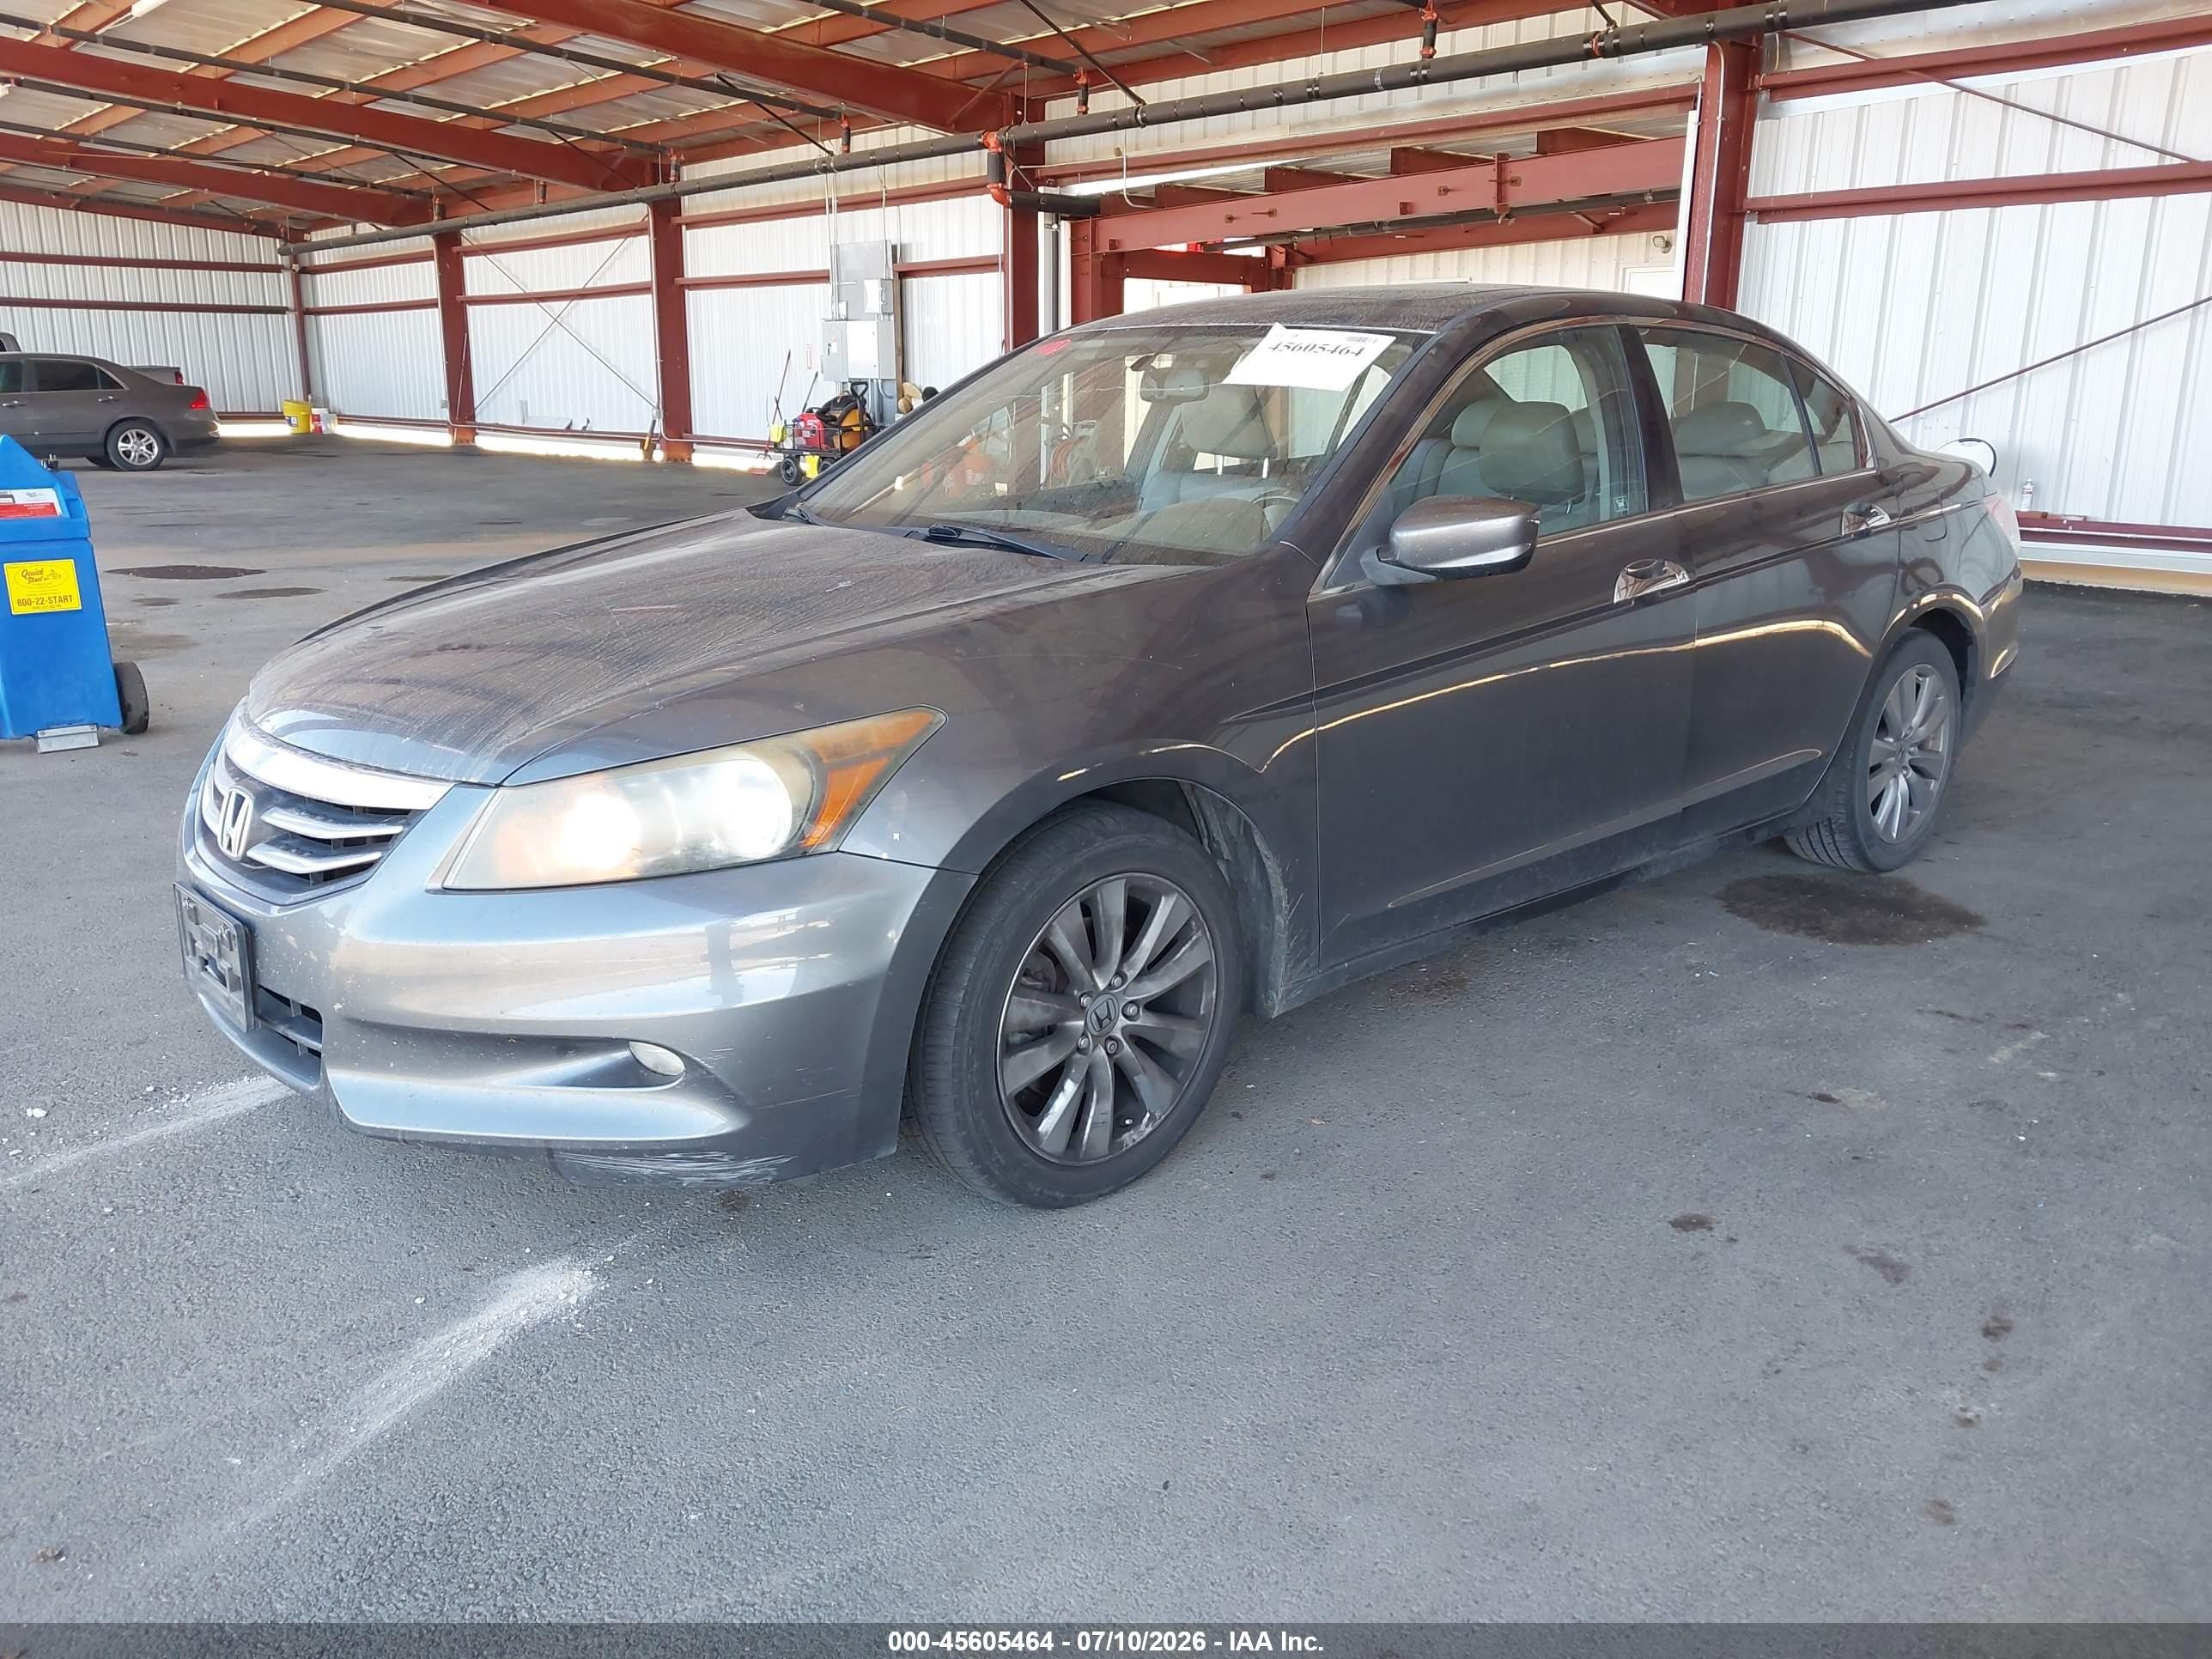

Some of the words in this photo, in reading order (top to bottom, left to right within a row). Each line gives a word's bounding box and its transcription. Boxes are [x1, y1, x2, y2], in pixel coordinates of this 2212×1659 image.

[1268, 342, 1365, 356] 45605464
[21, 567, 44, 580] Quick
[17, 595, 73, 606] 800-22-START
